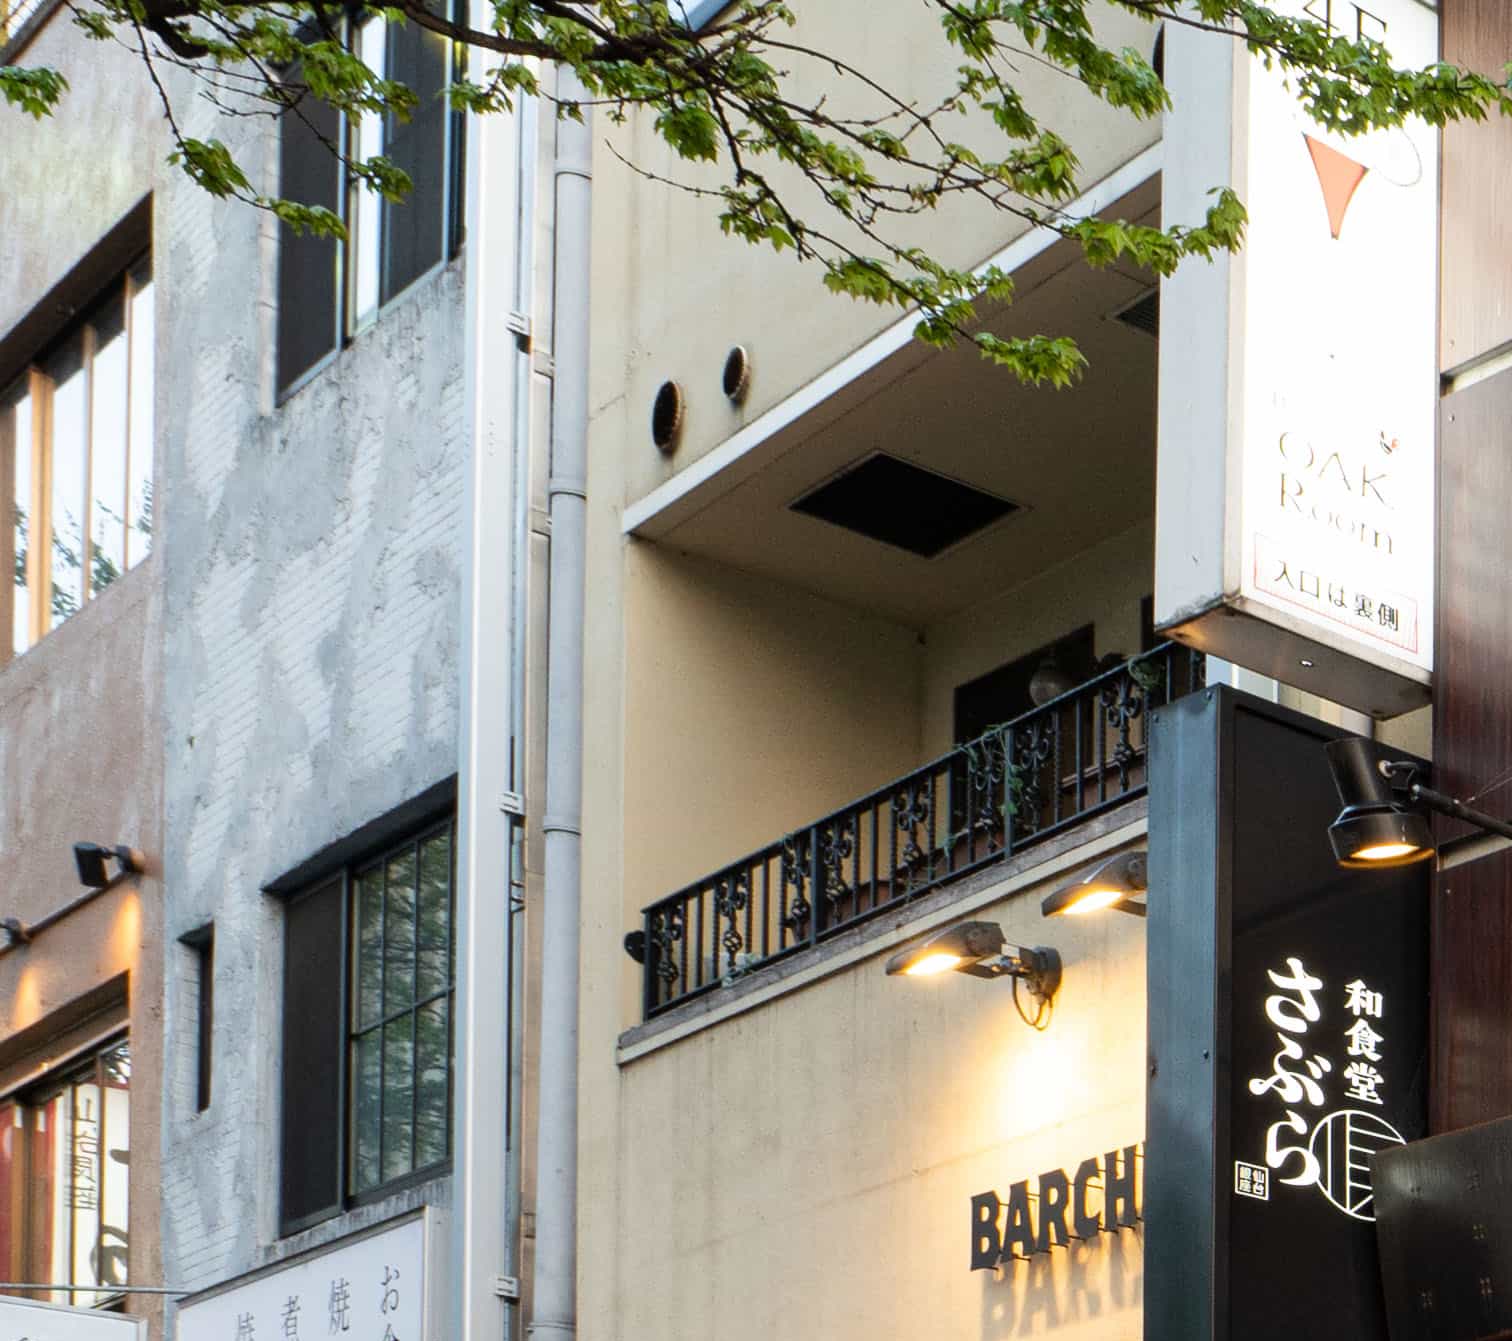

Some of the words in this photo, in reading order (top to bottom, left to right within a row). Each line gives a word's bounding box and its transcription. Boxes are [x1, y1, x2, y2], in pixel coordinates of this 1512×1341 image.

[1279, 431, 1395, 510] OAK
[1274, 559, 1399, 632] 入口は裏側
[1248, 957, 1332, 1187] さぶら
[1343, 979, 1385, 1105] 和食堂
[970, 1141, 1146, 1271] BARCH
